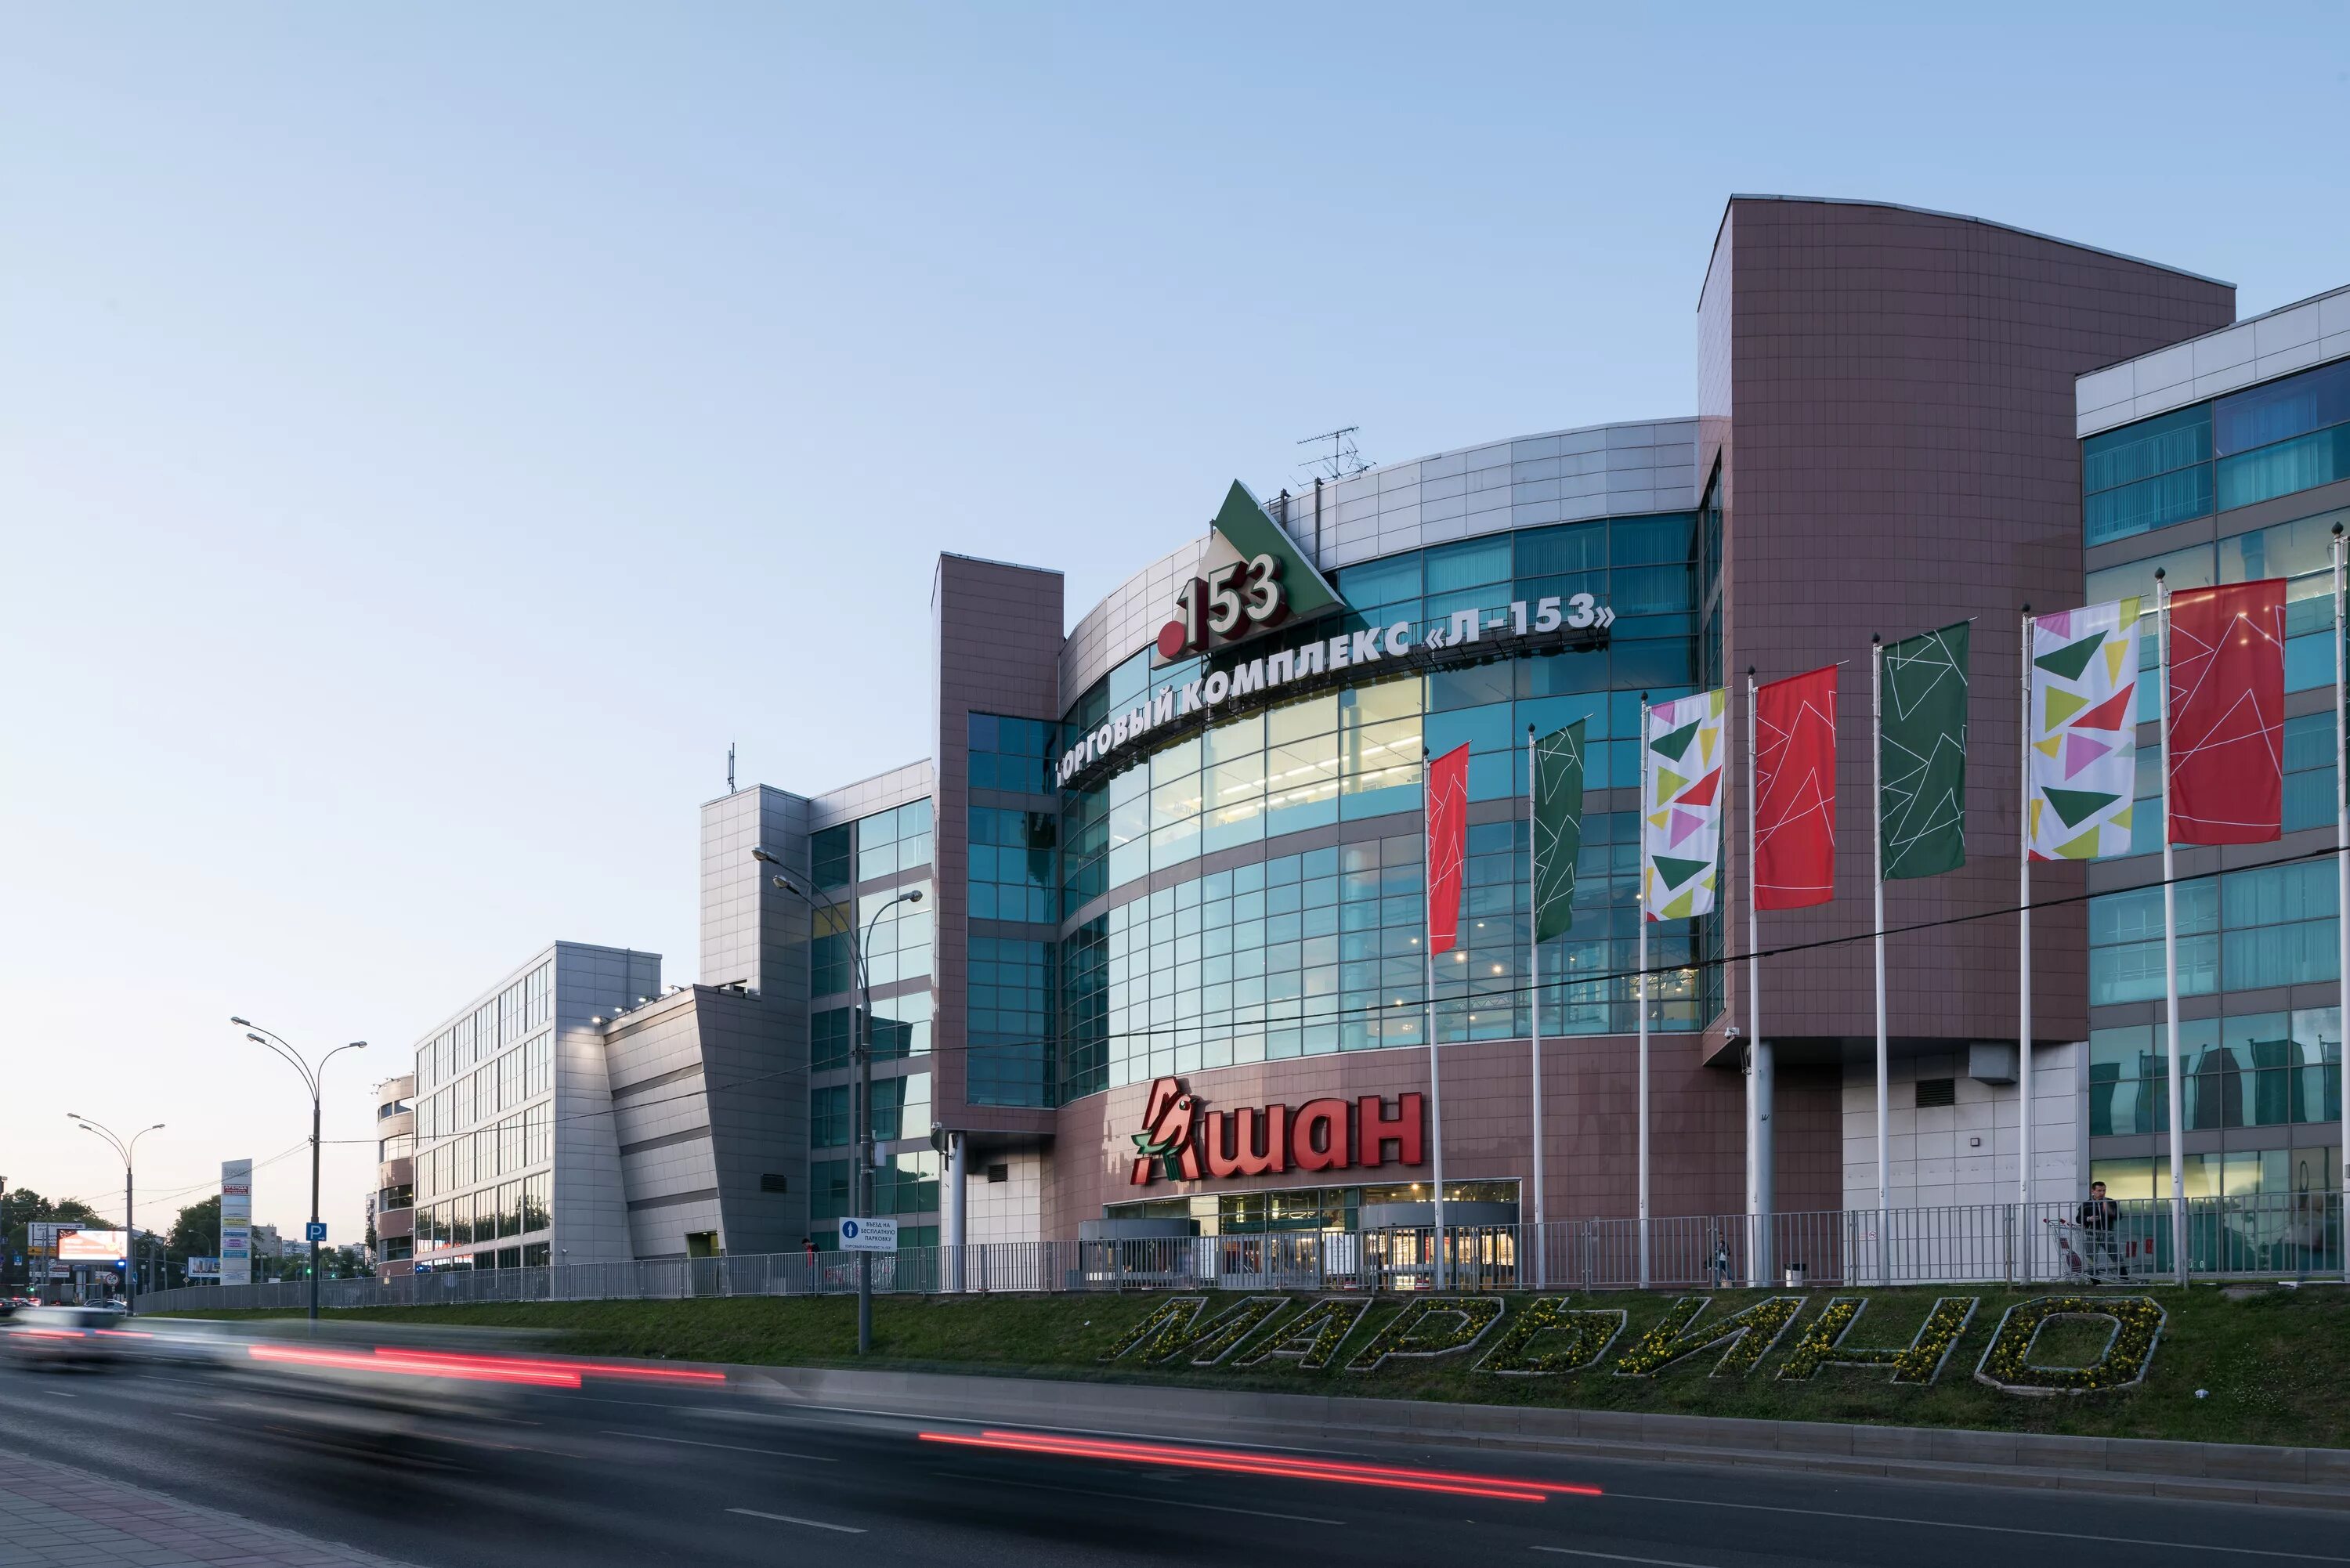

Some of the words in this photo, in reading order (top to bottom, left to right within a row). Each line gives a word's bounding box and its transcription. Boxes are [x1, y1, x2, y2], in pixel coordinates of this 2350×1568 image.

[1177, 554, 1285, 649] 153
[1055, 682, 1177, 789] ТОРГОВЫЙ
[1180, 620, 1411, 716] КОМПЛЕКС
[1130, 1075, 1423, 1186] Ашан
[310, 1225, 323, 1240] P
[1097, 1295, 2167, 1396] МАРЬИНО
